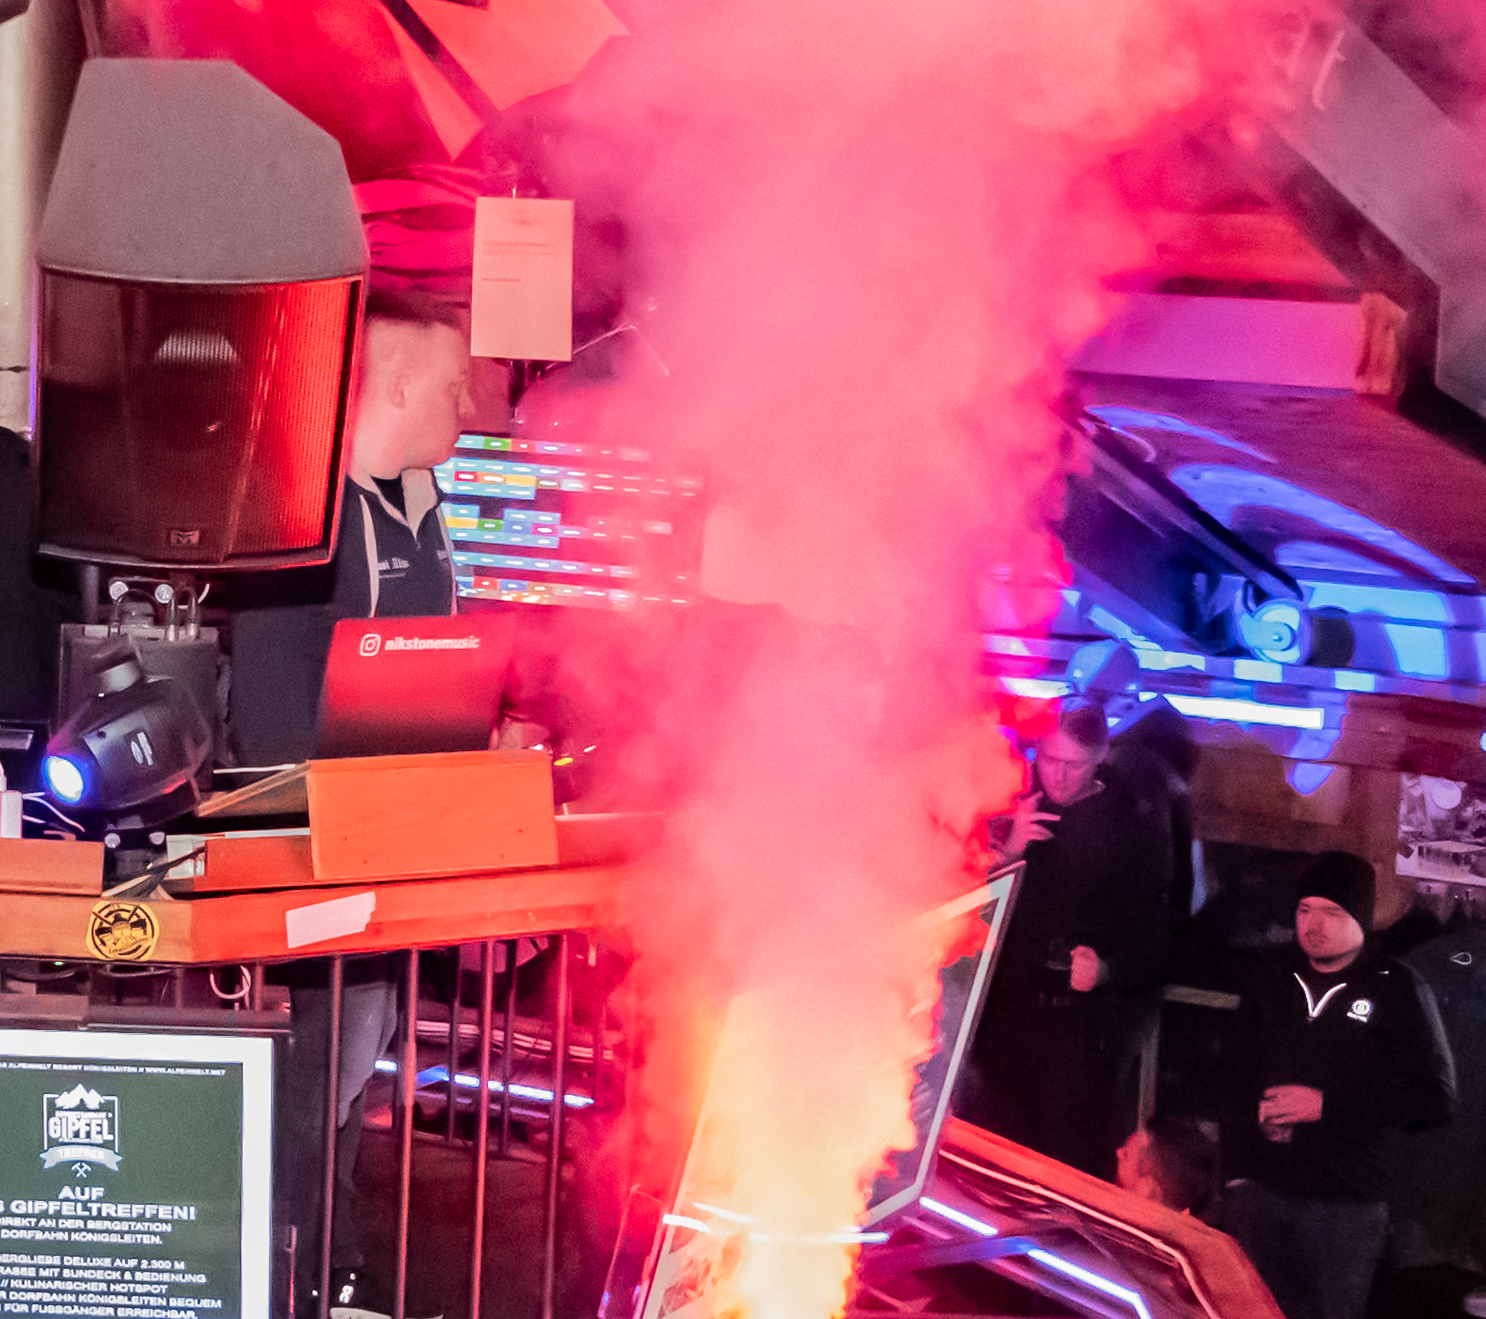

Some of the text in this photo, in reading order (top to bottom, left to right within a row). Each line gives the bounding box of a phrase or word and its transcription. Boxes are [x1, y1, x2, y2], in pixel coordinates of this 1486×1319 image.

[385, 635, 481, 651] nikstonemusic
[48, 1116, 114, 1141] GIPFEL
[58, 1185, 105, 1201] AUF
[38, 1217, 56, 1228] AN
[58, 1218, 84, 1229] DER
[86, 1219, 172, 1232] BERGSTATION
[0, 1229, 163, 1244] DORFBAHN KÖNIGSLEITEN.
[63, 1256, 112, 1267] DELUXE
[113, 1258, 138, 1268] AUF
[140, 1259, 172, 1270] 2.300
[174, 1260, 186, 1270] M
[39, 1267, 60, 1278] MIT
[62, 1268, 121, 1280] SUNDECK
[135, 1271, 206, 1284] BEDIENUNG
[10, 1279, 108, 1292] KULINARISCHER
[110, 1282, 168, 1294] HOTSPOT
[9, 1290, 76, 1303] DORFBAHN
[78, 1292, 166, 1306] KÖNIGSLEITEN
[169, 1296, 222, 1308] BEQUEM
[4, 1301, 30, 1313] FÜR
[32, 1303, 115, 1316] FUSSGÄNGER
[117, 1306, 198, 1319] ERREICHBAR.
